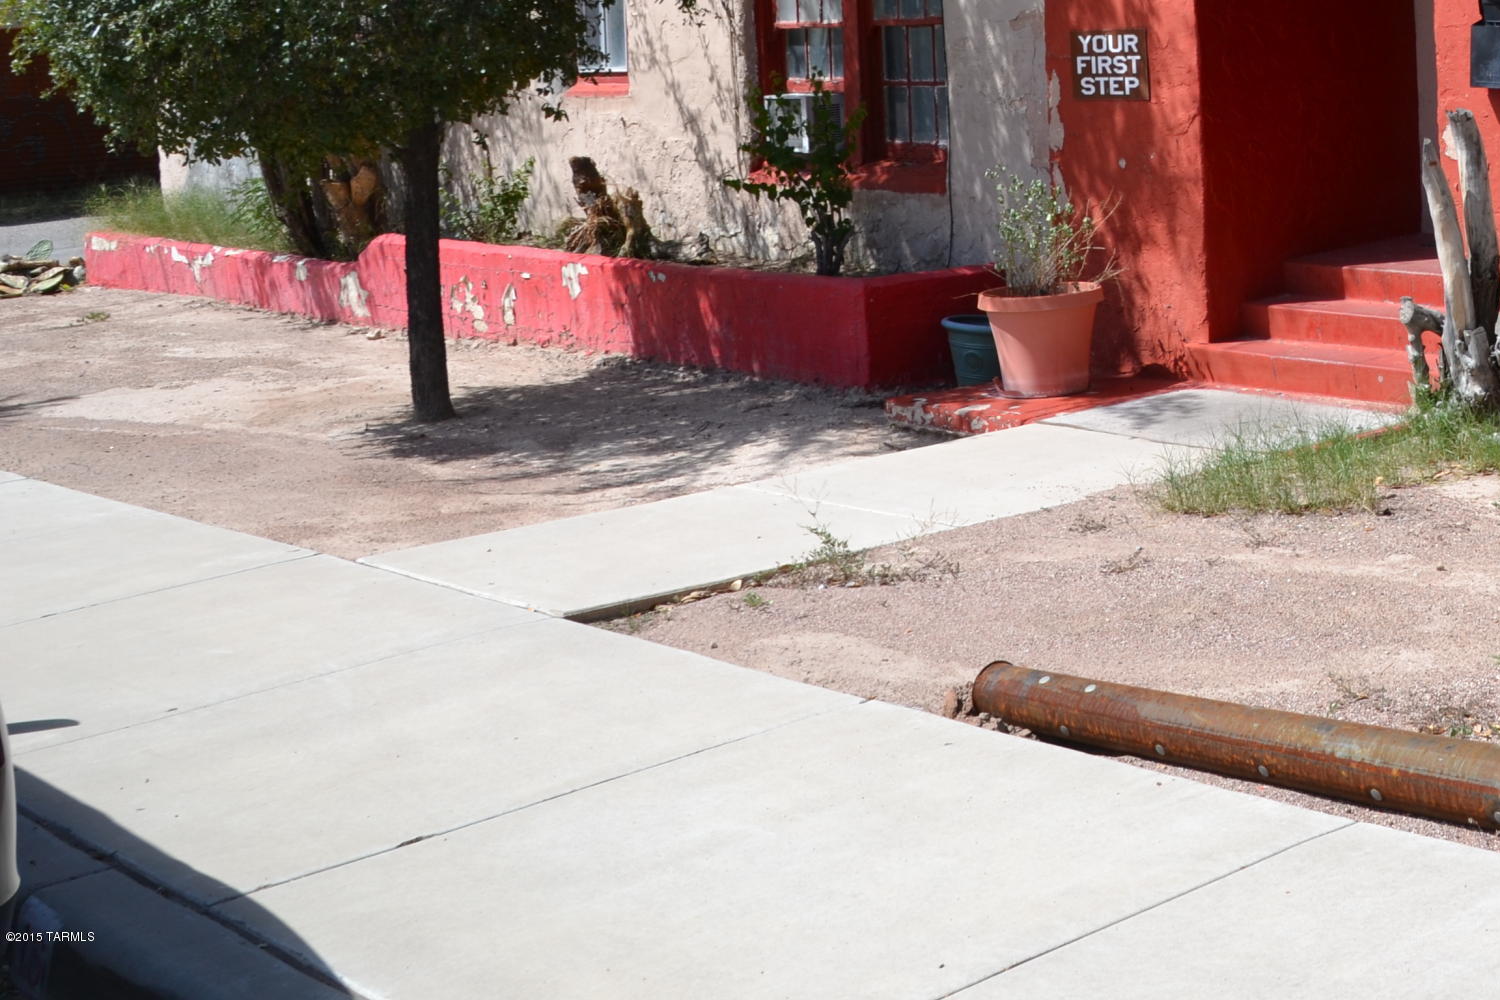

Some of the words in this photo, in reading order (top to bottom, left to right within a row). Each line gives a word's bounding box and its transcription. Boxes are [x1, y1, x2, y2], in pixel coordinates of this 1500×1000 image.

[1078, 34, 1139, 53] YOUR
[1076, 56, 1141, 75] FIRST
[1080, 77, 1140, 96] STEP
